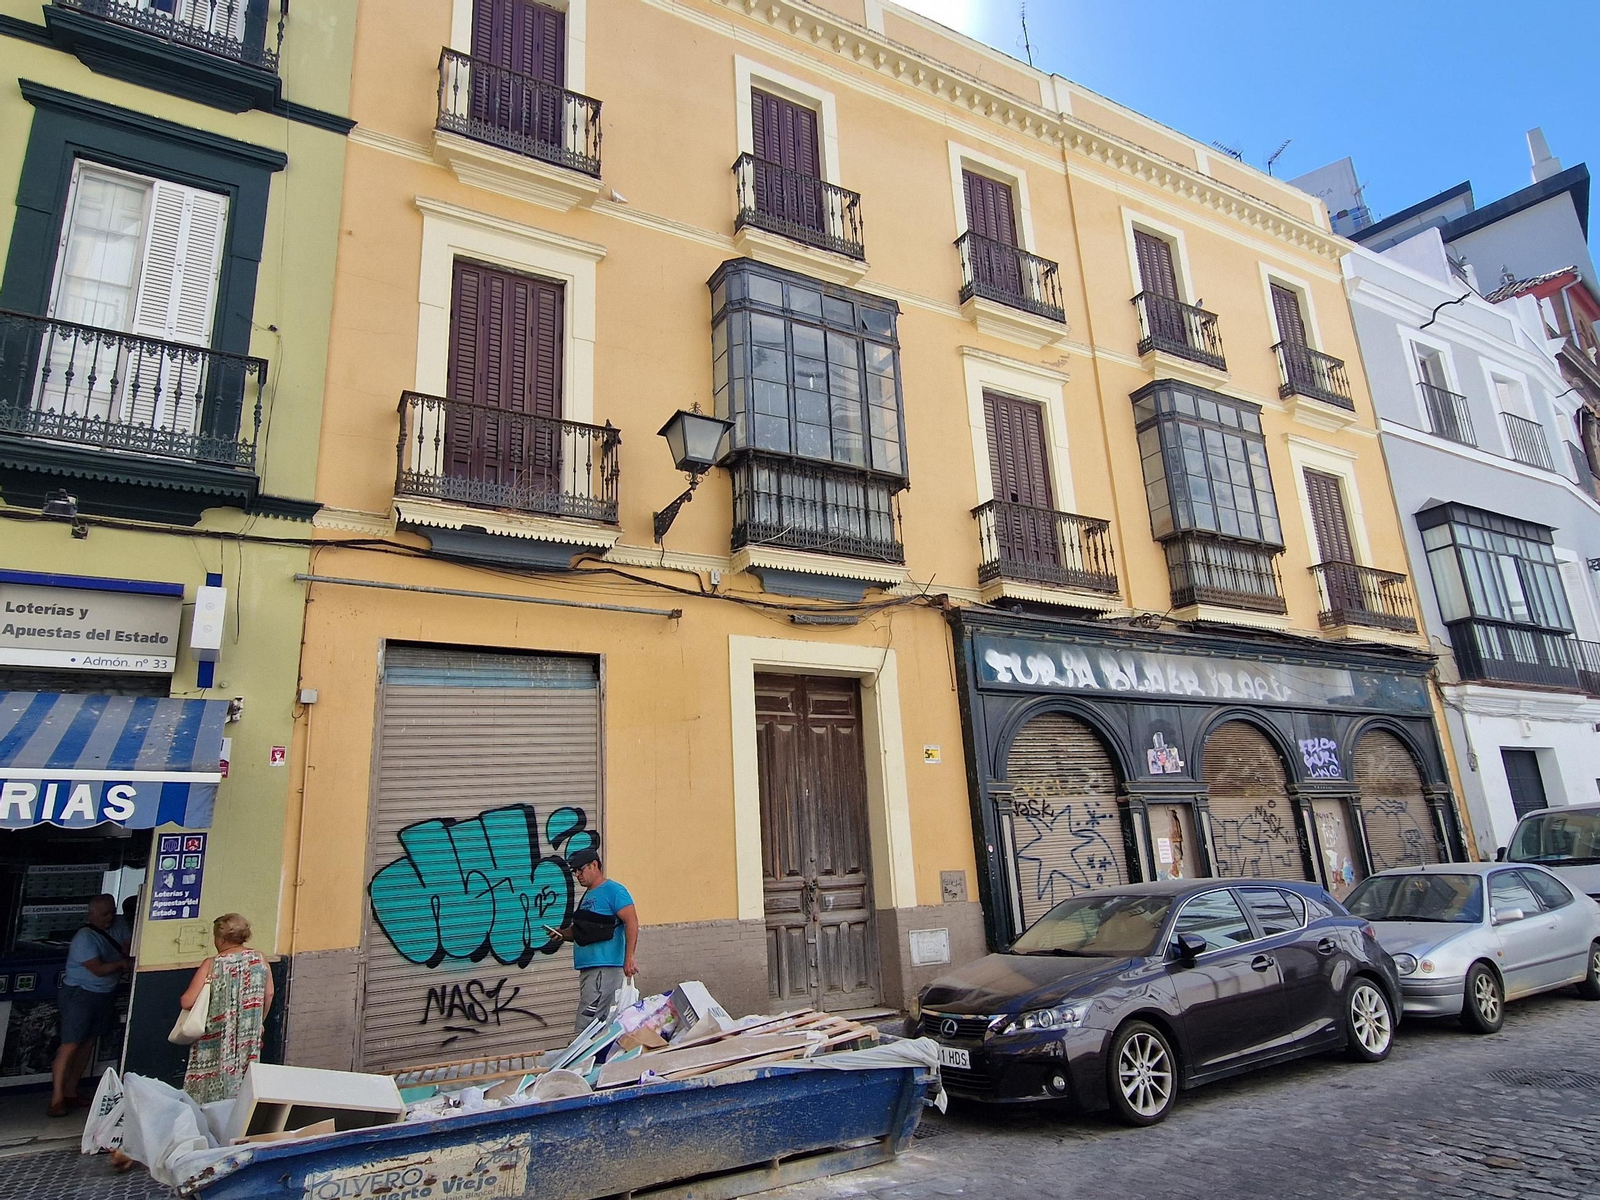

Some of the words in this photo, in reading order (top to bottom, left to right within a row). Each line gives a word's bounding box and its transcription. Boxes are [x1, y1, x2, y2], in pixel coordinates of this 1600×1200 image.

[5, 601, 75, 616] Loterías
[79, 608, 89, 620] y
[1, 623, 81, 639] Apuestas
[85, 628, 110, 641] del
[114, 630, 169, 645] Estado
[152, 659, 168, 669] 33
[0, 782, 137, 820] RIAS
[152, 909, 177, 917] Estado
[948, 1050, 967, 1066] HDS
[442, 1173, 498, 1194] Viejo
